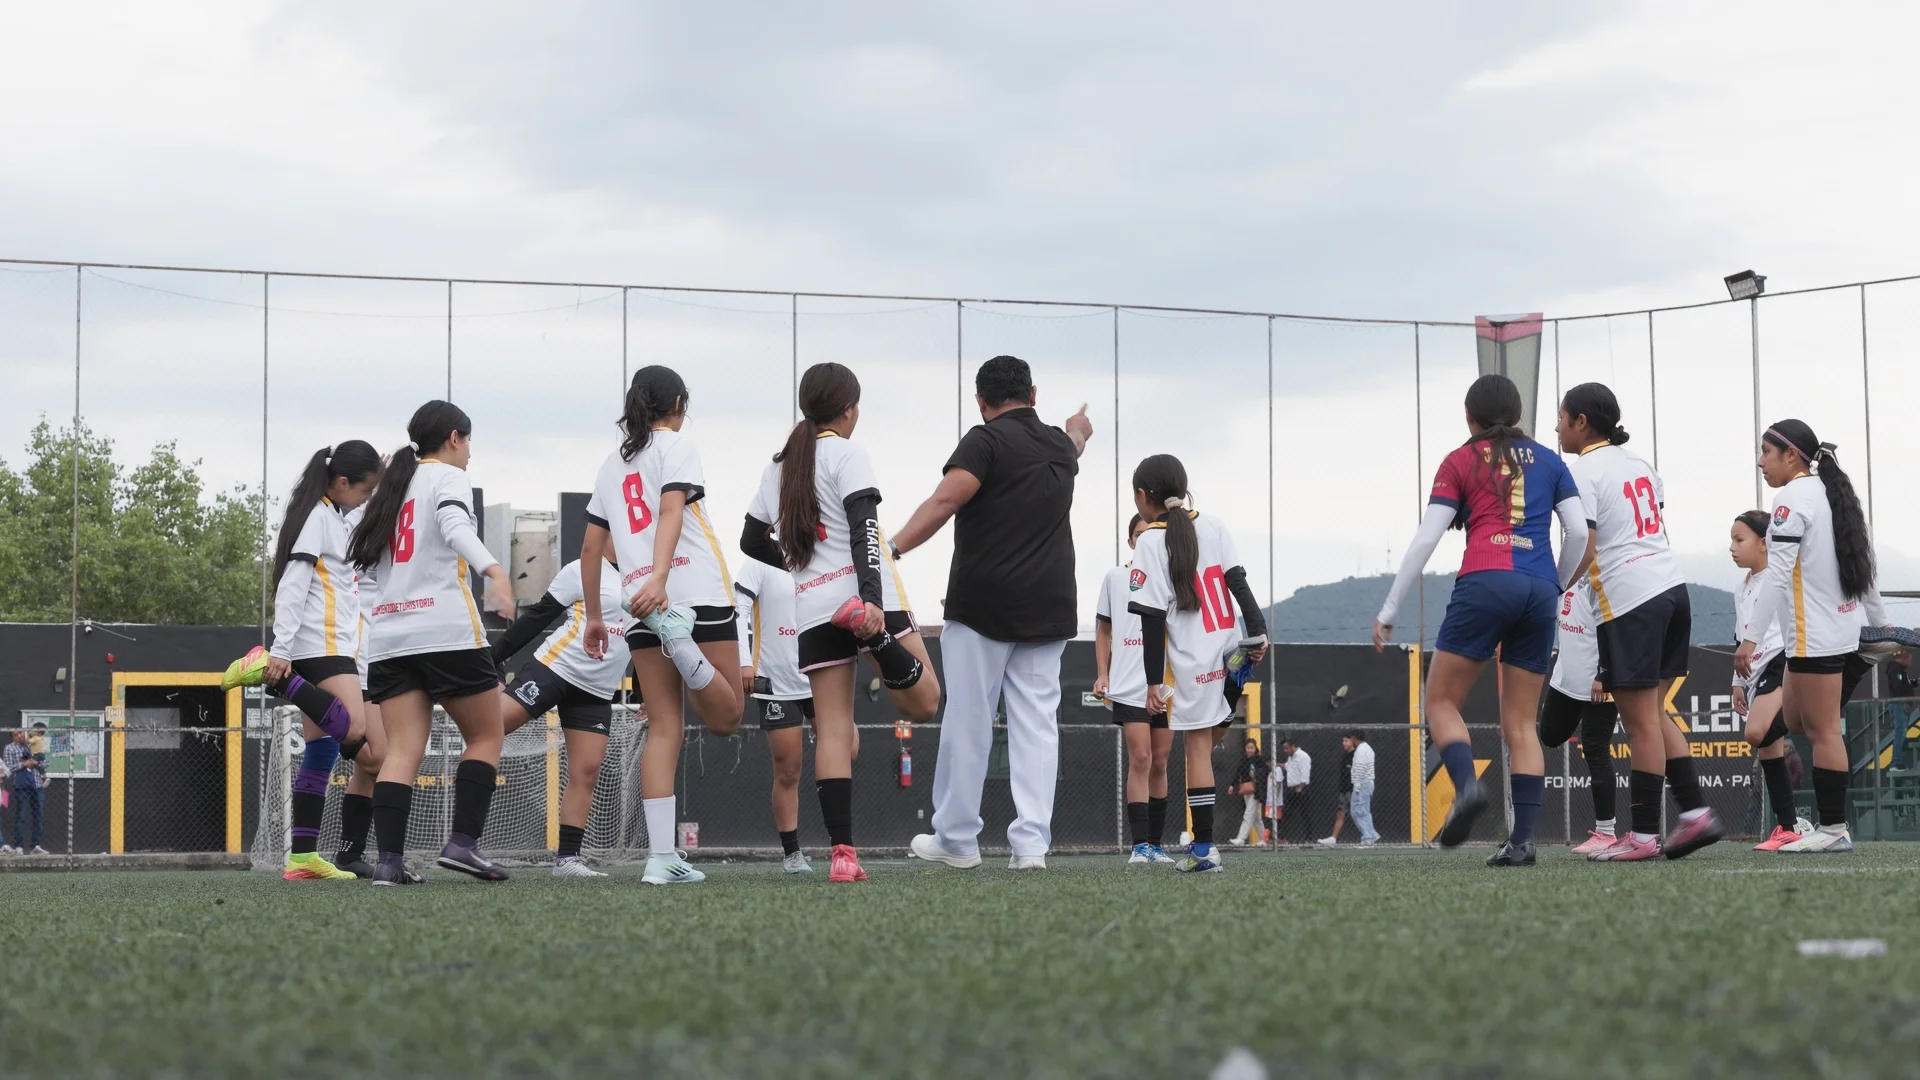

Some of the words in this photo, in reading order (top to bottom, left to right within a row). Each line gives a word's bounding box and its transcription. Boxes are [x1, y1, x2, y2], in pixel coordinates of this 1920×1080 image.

[622, 471, 652, 534] 8
[1623, 476, 1660, 539] 13
[866, 518, 881, 572] CHARLY
[1193, 564, 1235, 633] 10
[779, 626, 797, 636] Sco
[1690, 741, 1753, 758] ENTER
